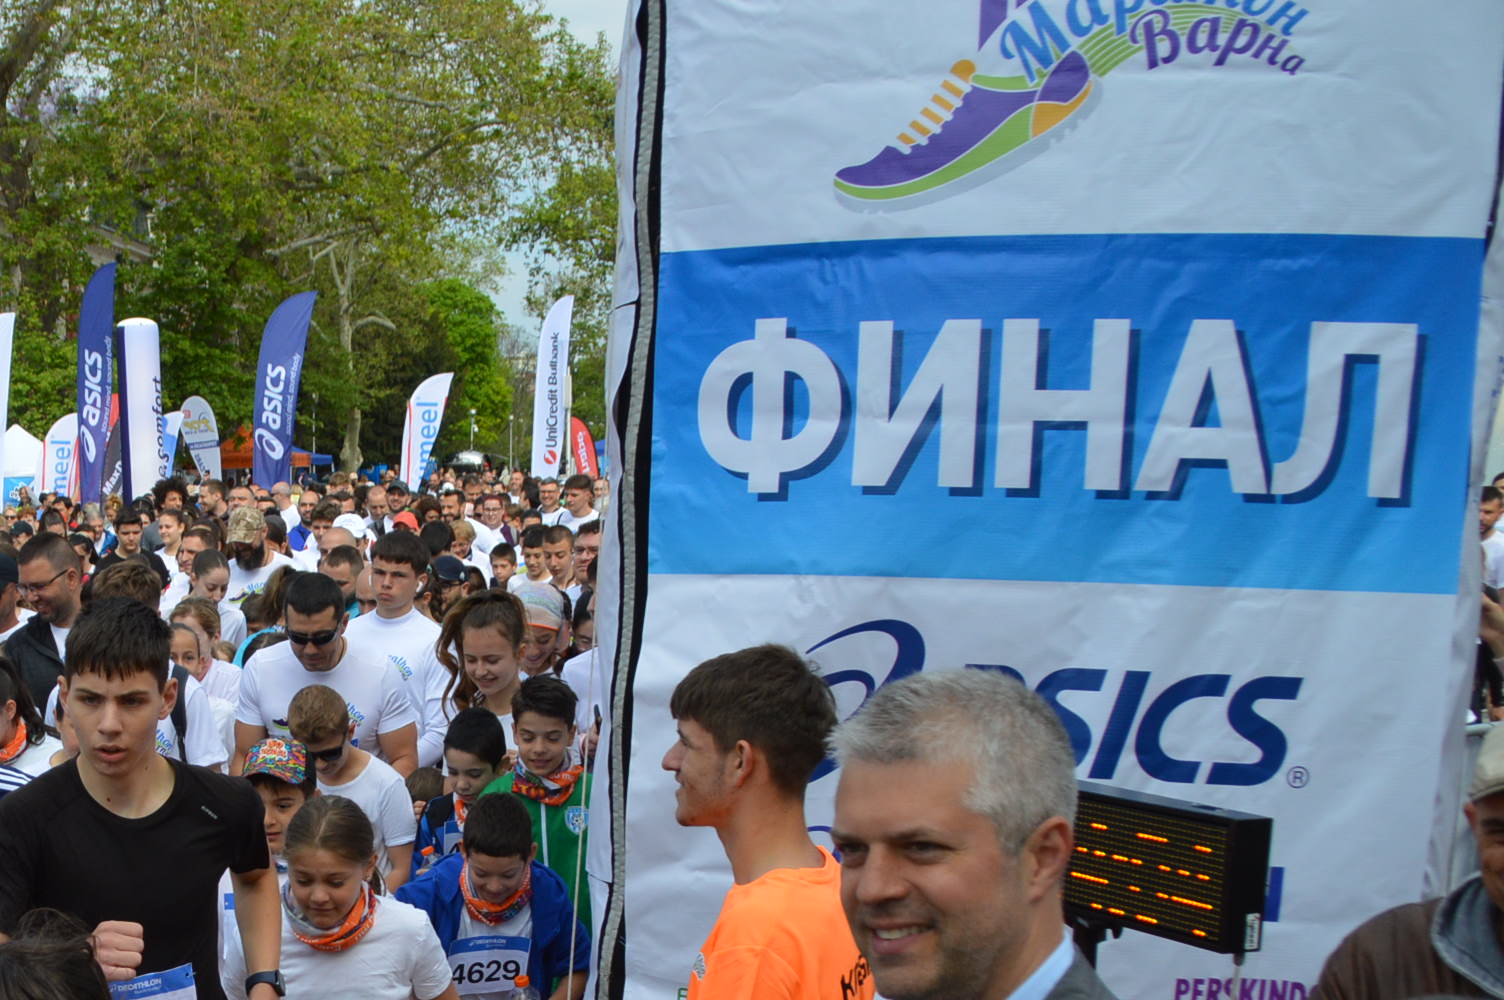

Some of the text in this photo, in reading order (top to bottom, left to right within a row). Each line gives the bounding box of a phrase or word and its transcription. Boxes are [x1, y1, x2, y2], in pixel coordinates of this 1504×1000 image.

[1129, 9, 1305, 76] Варна
[697, 317, 1423, 502] ФИНАЛ
[118, 978, 162, 992] DECATHLON
[451, 960, 521, 985] 4629
